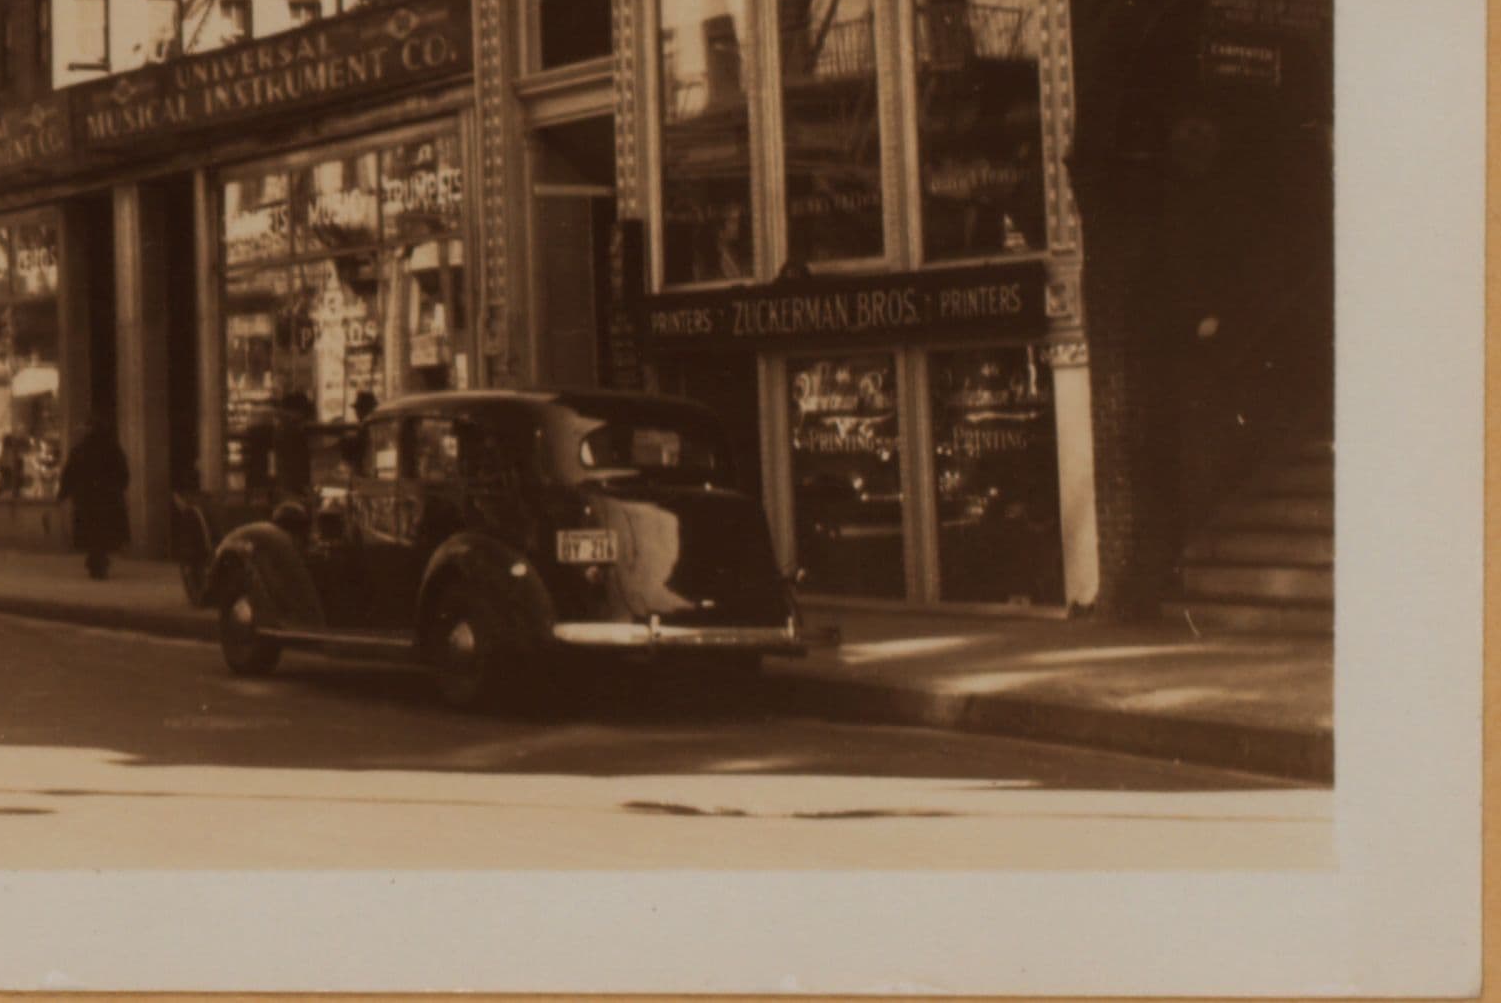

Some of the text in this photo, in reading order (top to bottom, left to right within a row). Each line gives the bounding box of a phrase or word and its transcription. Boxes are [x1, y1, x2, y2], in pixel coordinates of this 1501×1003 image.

[86, 35, 458, 139] MUSICAL INSTRUMENT CO.
[175, 32, 333, 89] UNIVERSAL
[650, 284, 1022, 336] PRINTERS ZUCKERMAN BROS. PRINTERS
